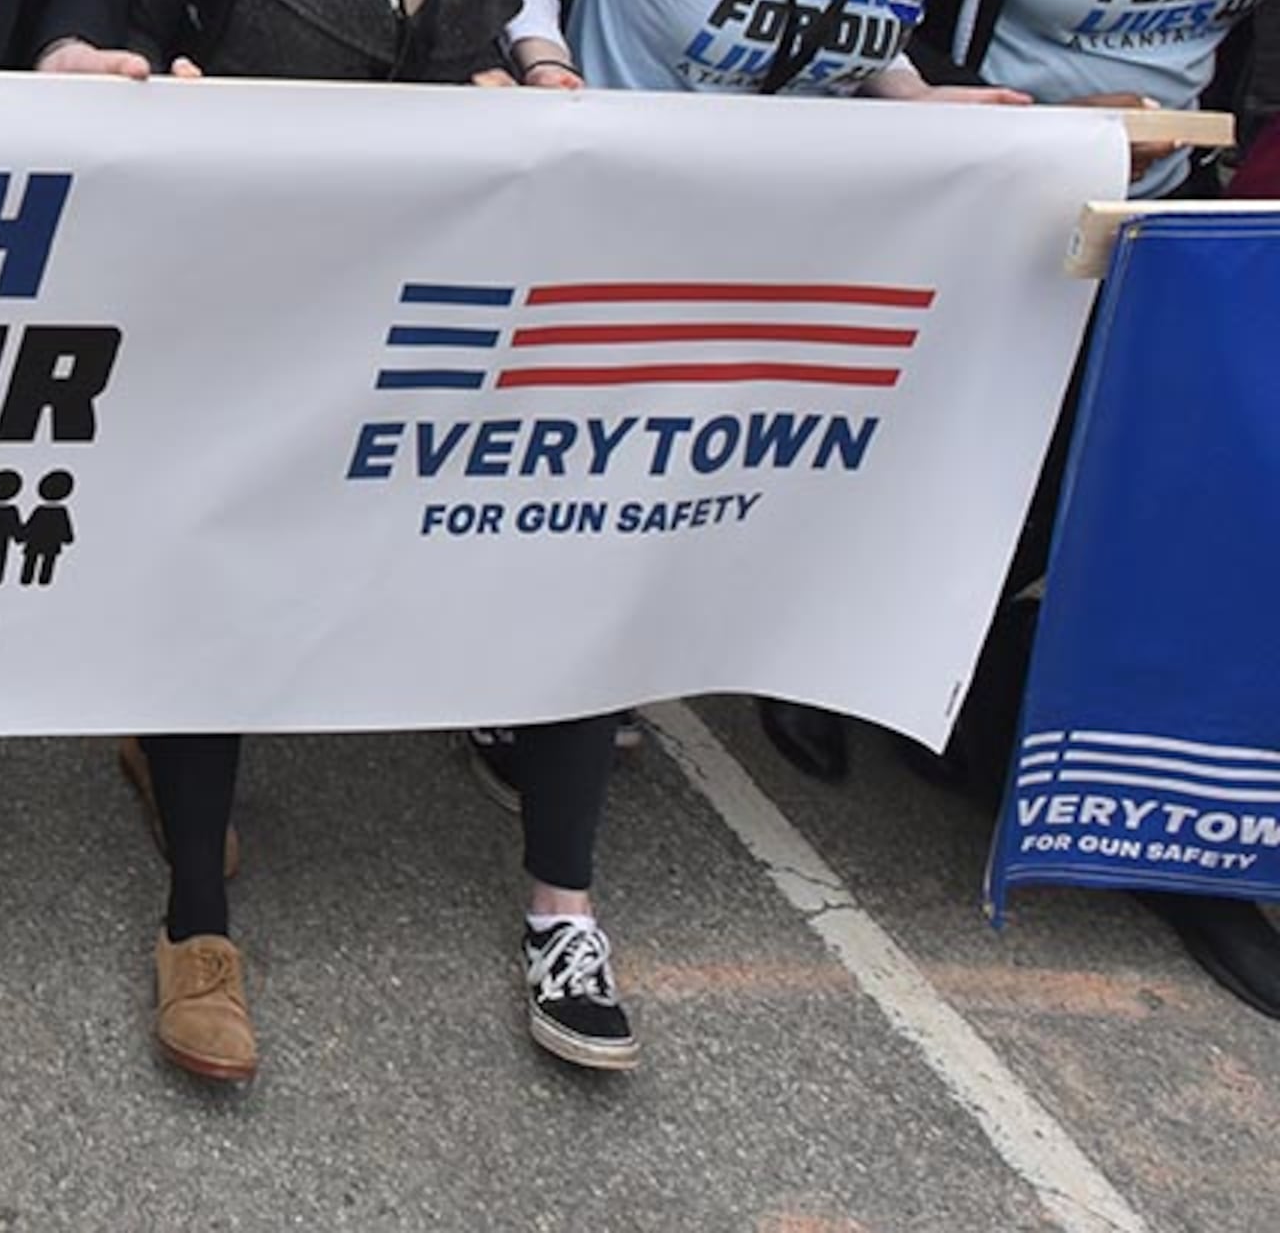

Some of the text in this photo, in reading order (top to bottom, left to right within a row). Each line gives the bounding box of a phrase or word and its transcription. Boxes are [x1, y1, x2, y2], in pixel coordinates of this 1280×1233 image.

[1066, 26, 1186, 53] ATLANTA
[344, 412, 880, 481] EVERYTOWN
[419, 493, 763, 536] FOR GUN SAFETY
[1019, 833, 1072, 853] FOR
[1146, 841, 1257, 870] SAFETY
